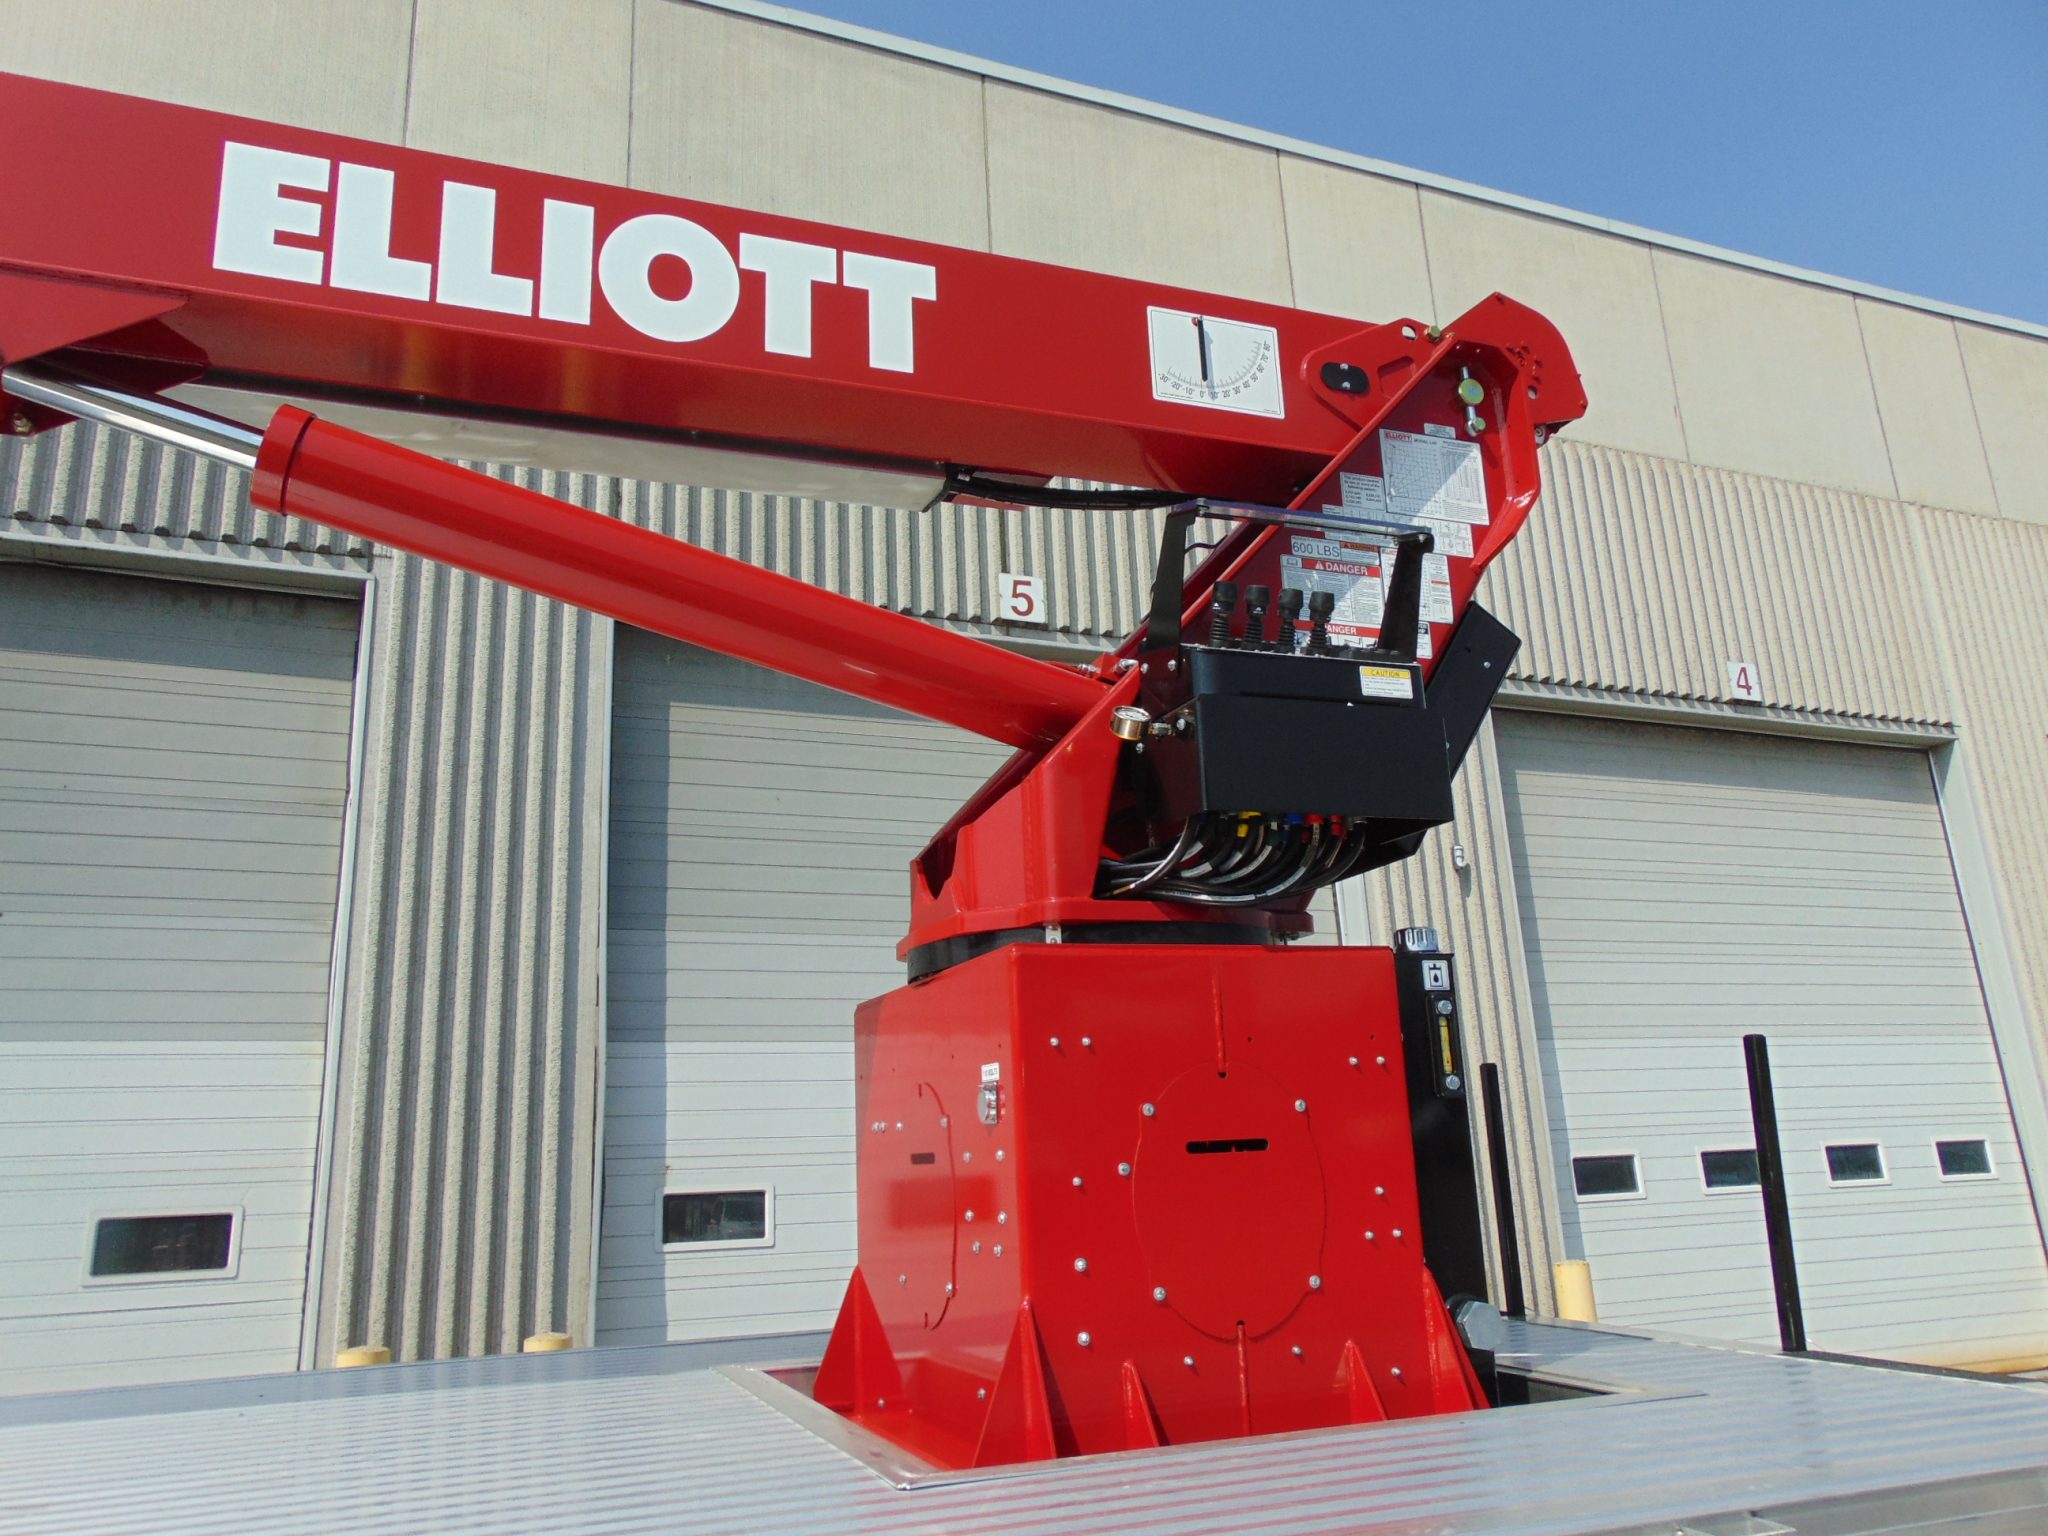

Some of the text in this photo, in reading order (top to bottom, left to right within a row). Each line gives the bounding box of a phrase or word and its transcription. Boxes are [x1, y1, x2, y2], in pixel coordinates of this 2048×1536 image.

[213, 140, 937, 374] ELLIOTT
[1292, 541, 1314, 555] 600
[1317, 545, 1340, 558] LBS
[1325, 562, 1368, 576] DANGER
[1011, 580, 1034, 616] 5
[1325, 624, 1357, 636] ANGER
[1371, 668, 1400, 678] CAUTION
[1737, 667, 1752, 696] 4
